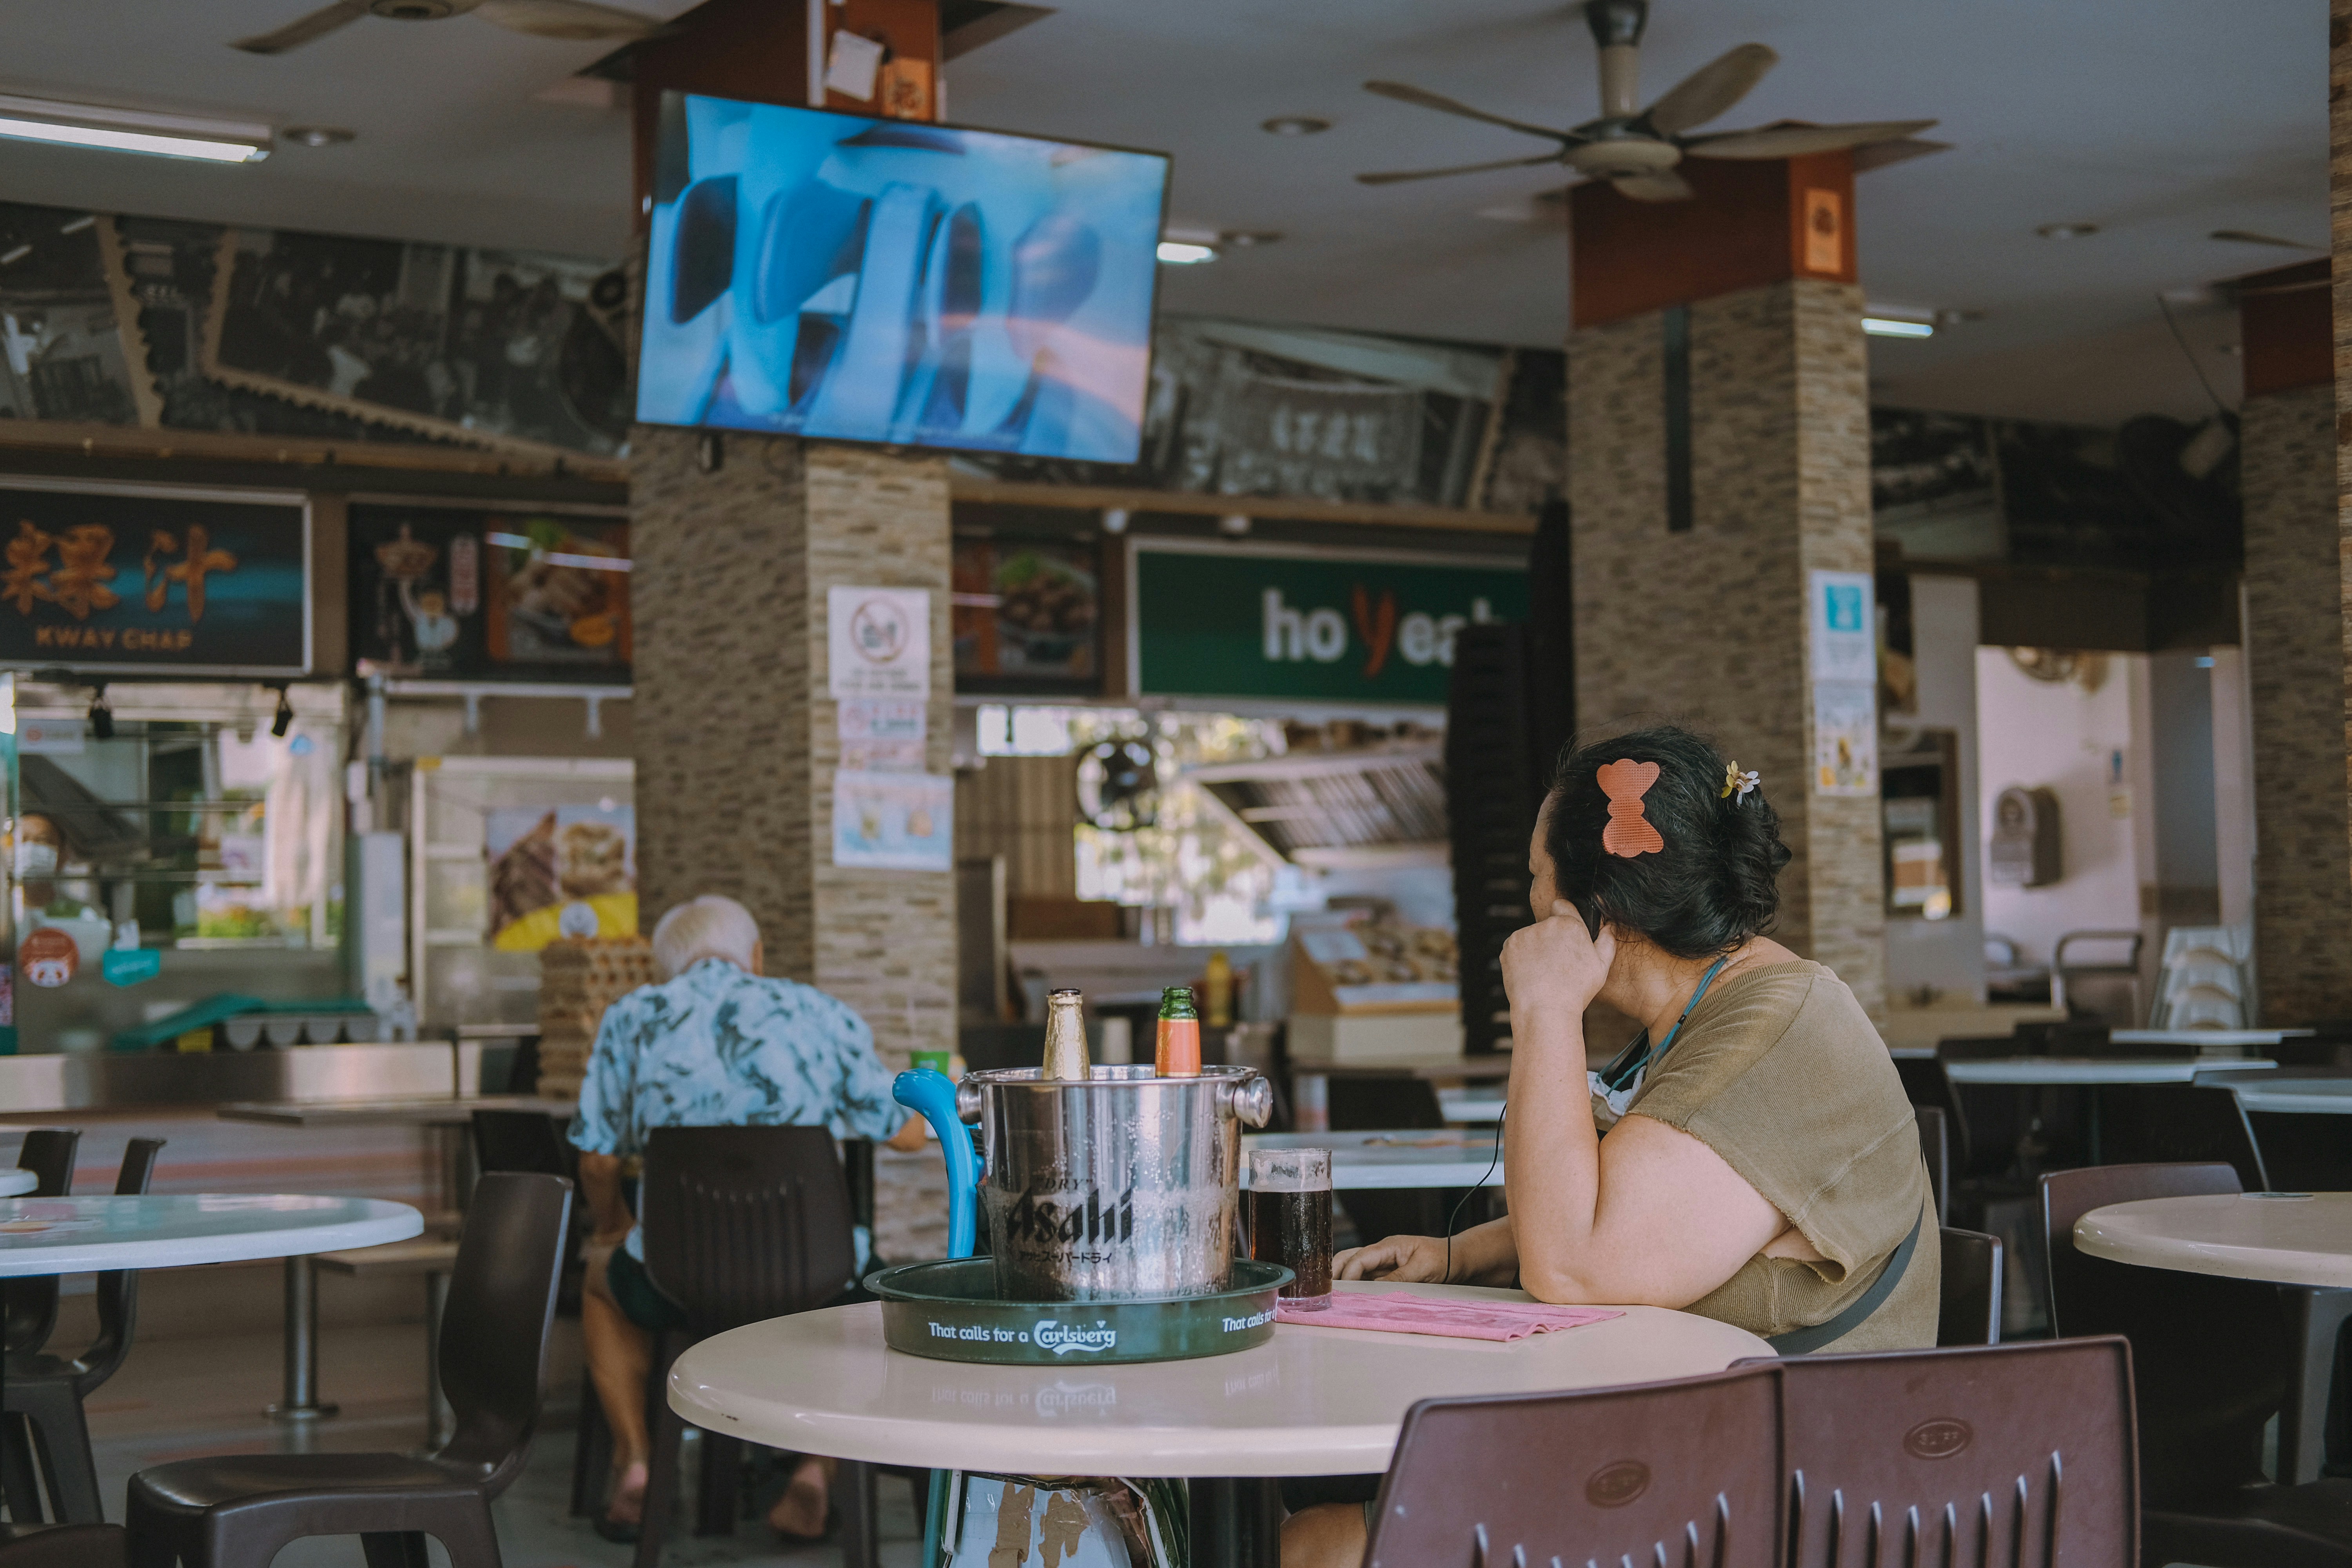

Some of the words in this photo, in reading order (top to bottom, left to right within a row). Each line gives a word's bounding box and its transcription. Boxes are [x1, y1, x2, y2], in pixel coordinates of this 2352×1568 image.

[35, 625, 116, 649] KWAY
[1007, 1187, 1132, 1243] Asahi
[928, 1322, 957, 1339] That
[959, 1328, 990, 1341] calls
[993, 1328, 1015, 1342] for
[1018, 1332, 1029, 1343] a
[1034, 1319, 1116, 1355] Carlsberg
[1222, 1317, 1247, 1333] That
[1247, 1311, 1264, 1328] calls
